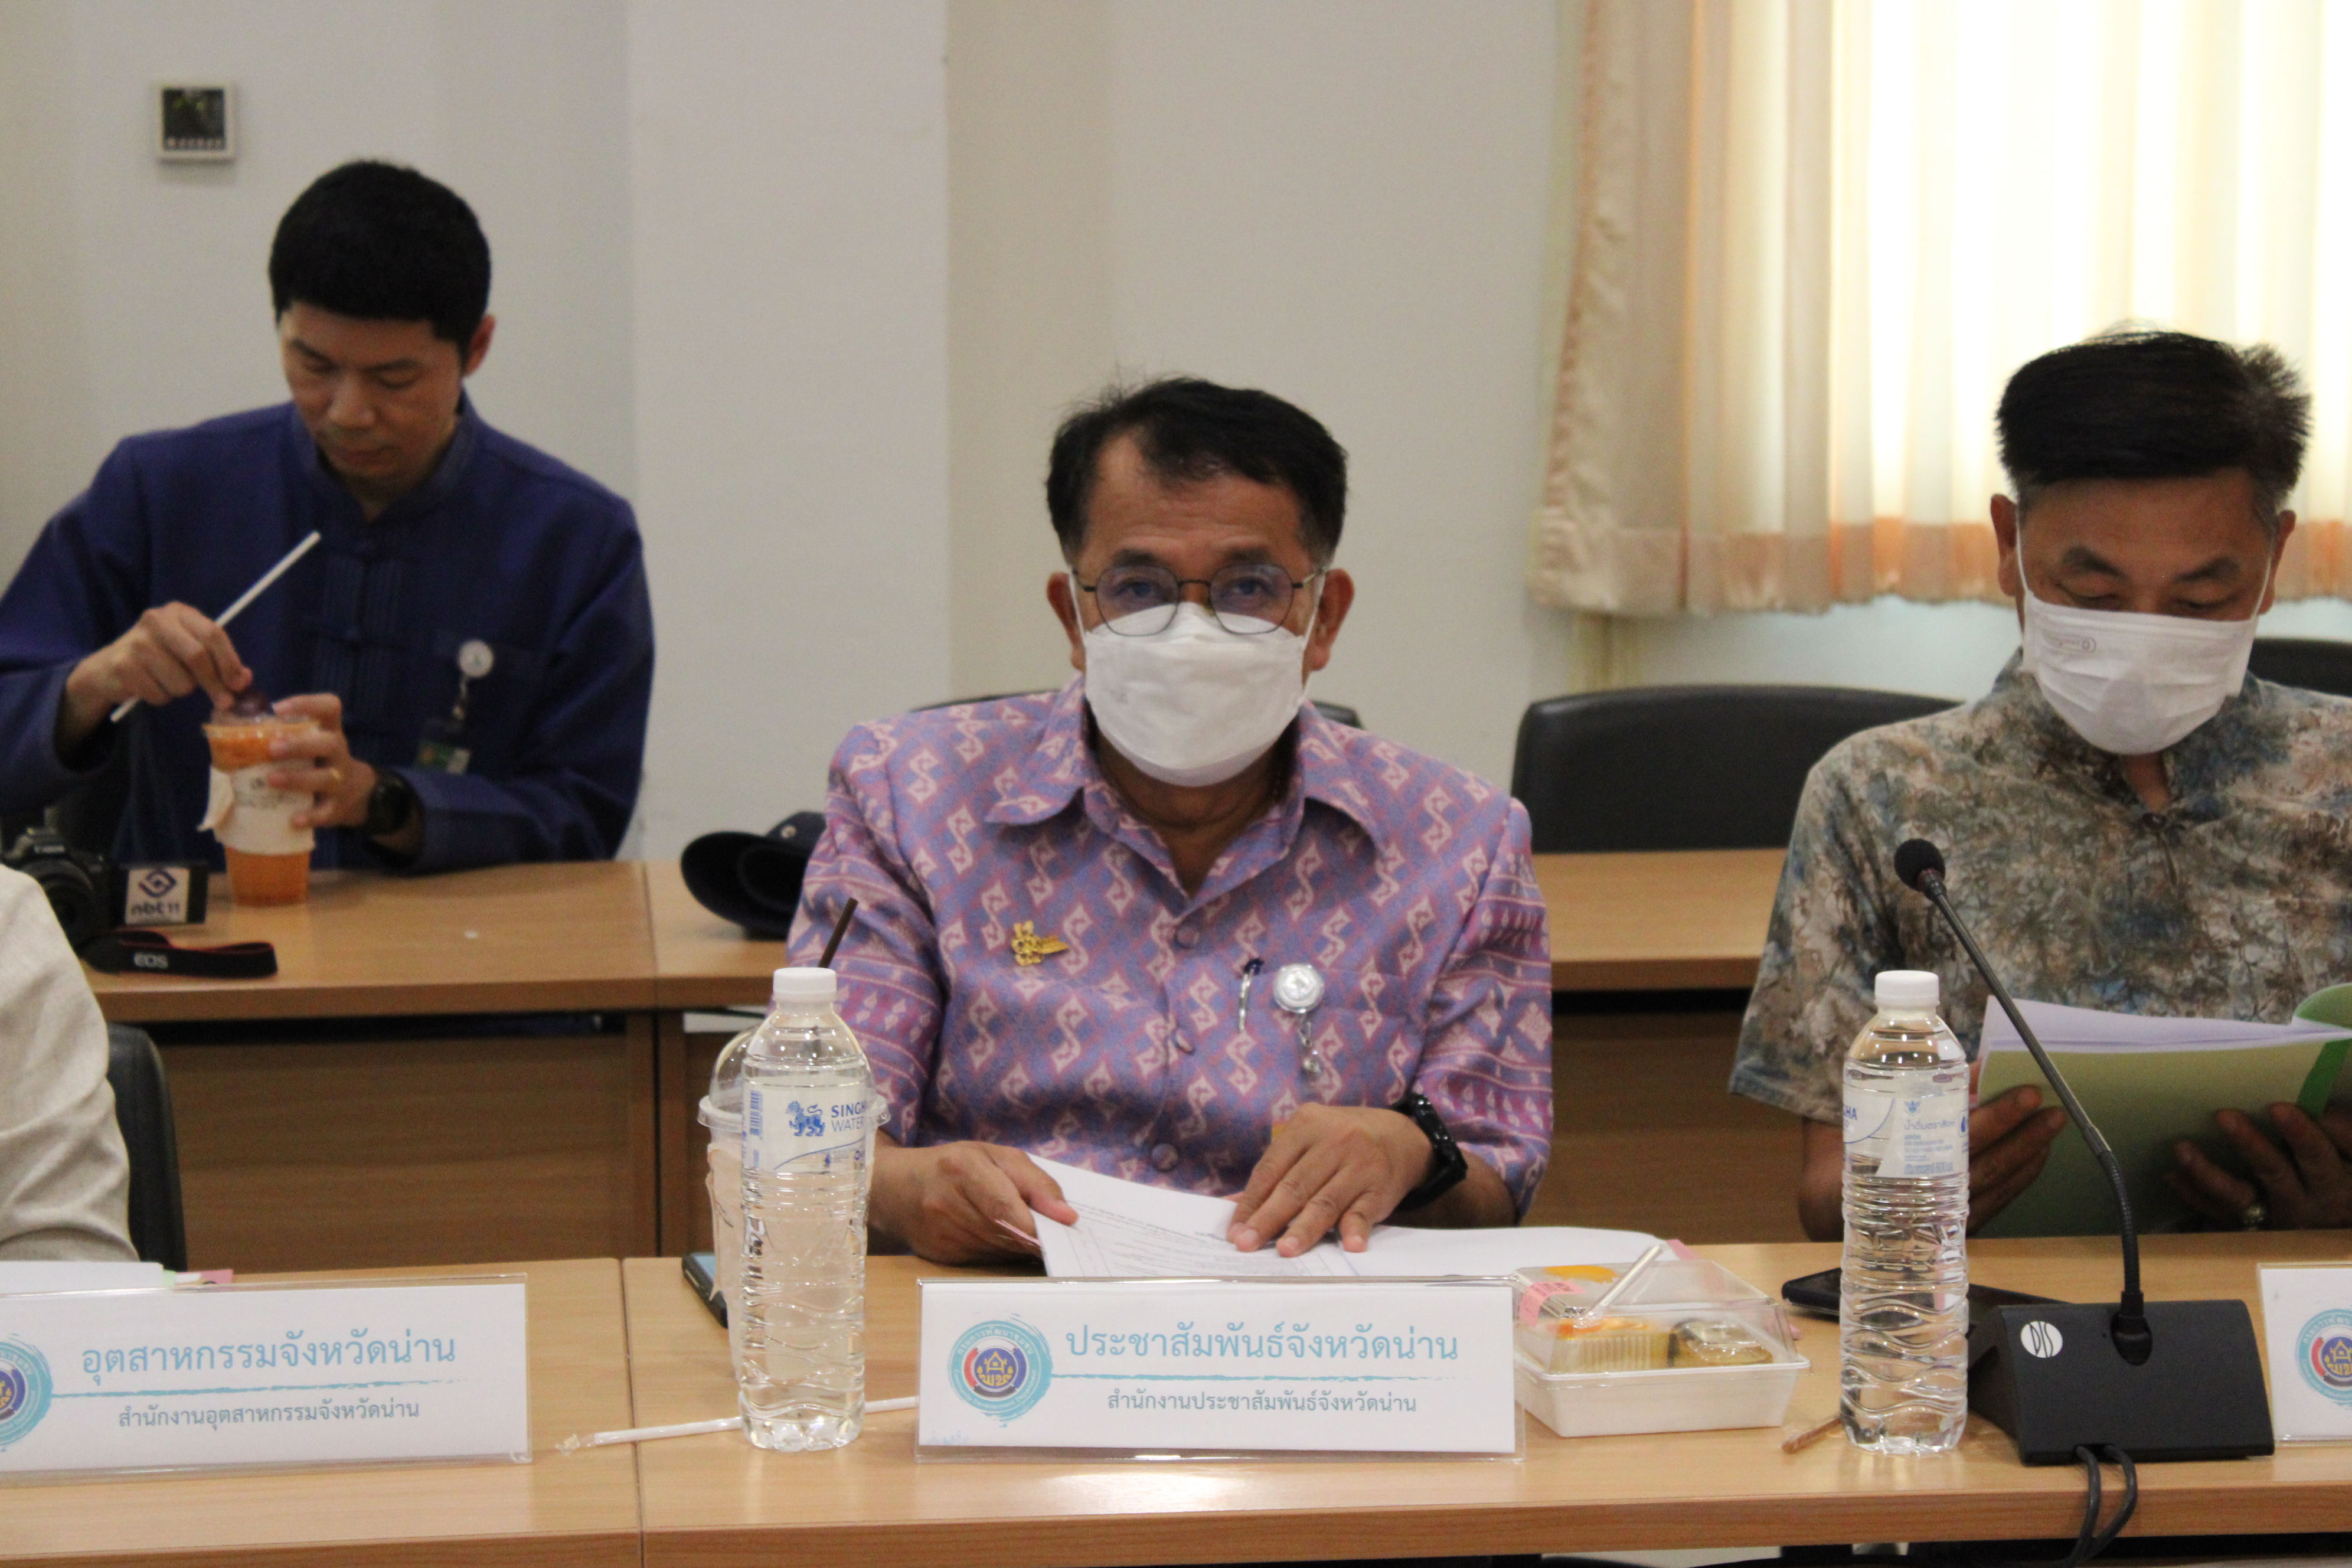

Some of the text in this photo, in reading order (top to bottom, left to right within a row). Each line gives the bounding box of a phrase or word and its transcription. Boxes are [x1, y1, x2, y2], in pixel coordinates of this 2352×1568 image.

[82, 1328, 456, 1386] อุตสาหกรรมจังหวัดน่าน
[1066, 1321, 1458, 1360] ประชาสัมพันธ์จังหวัดน่าน
[119, 1397, 419, 1431] สำนักงานอุตสาหกรรมจังหวัดน่าน
[1108, 1389, 1416, 1412] สำนักงานประชาสัมพันธ์จังหวัดน่าน
